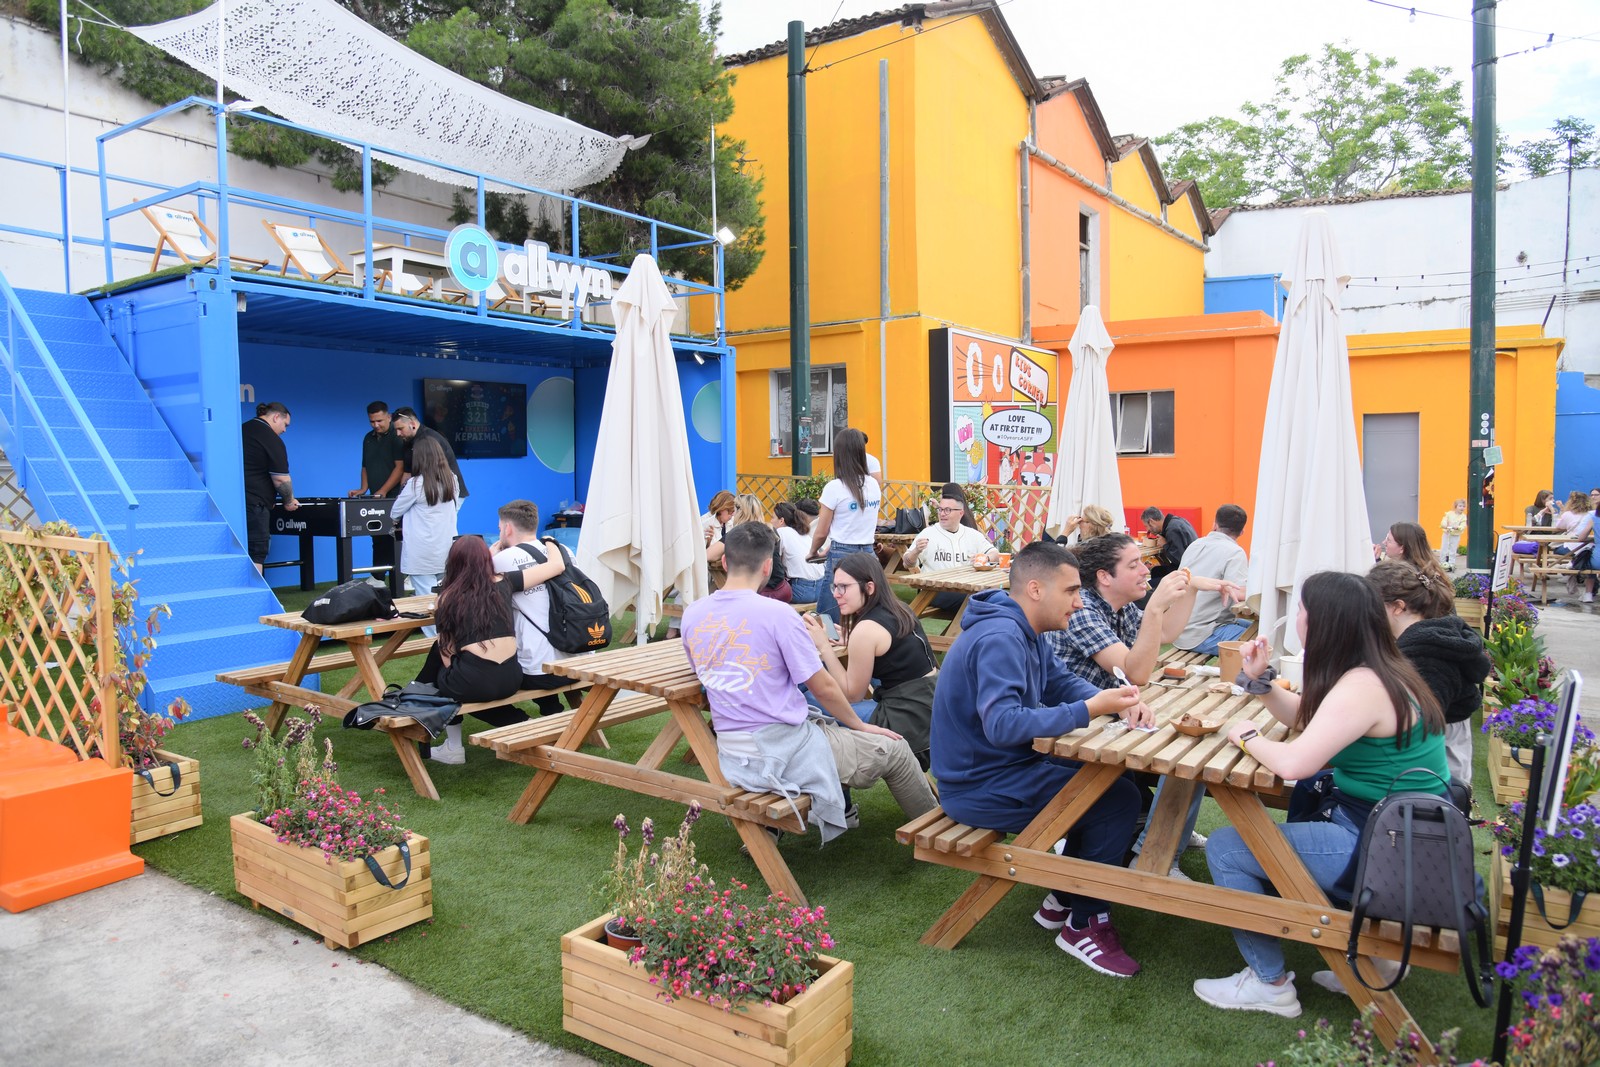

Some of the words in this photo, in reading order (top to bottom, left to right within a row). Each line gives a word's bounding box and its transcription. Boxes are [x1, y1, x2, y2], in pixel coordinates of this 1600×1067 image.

[503, 243, 612, 307] allwyn
[1015, 354, 1032, 378] KIDS
[1018, 374, 1044, 404] CORNER
[1008, 415, 1026, 423] LOVE
[1000, 425, 1020, 433] FIRST
[1020, 426, 1035, 434] BITE
[285, 518, 307, 532] allwyn
[587, 638, 606, 646] adidas
